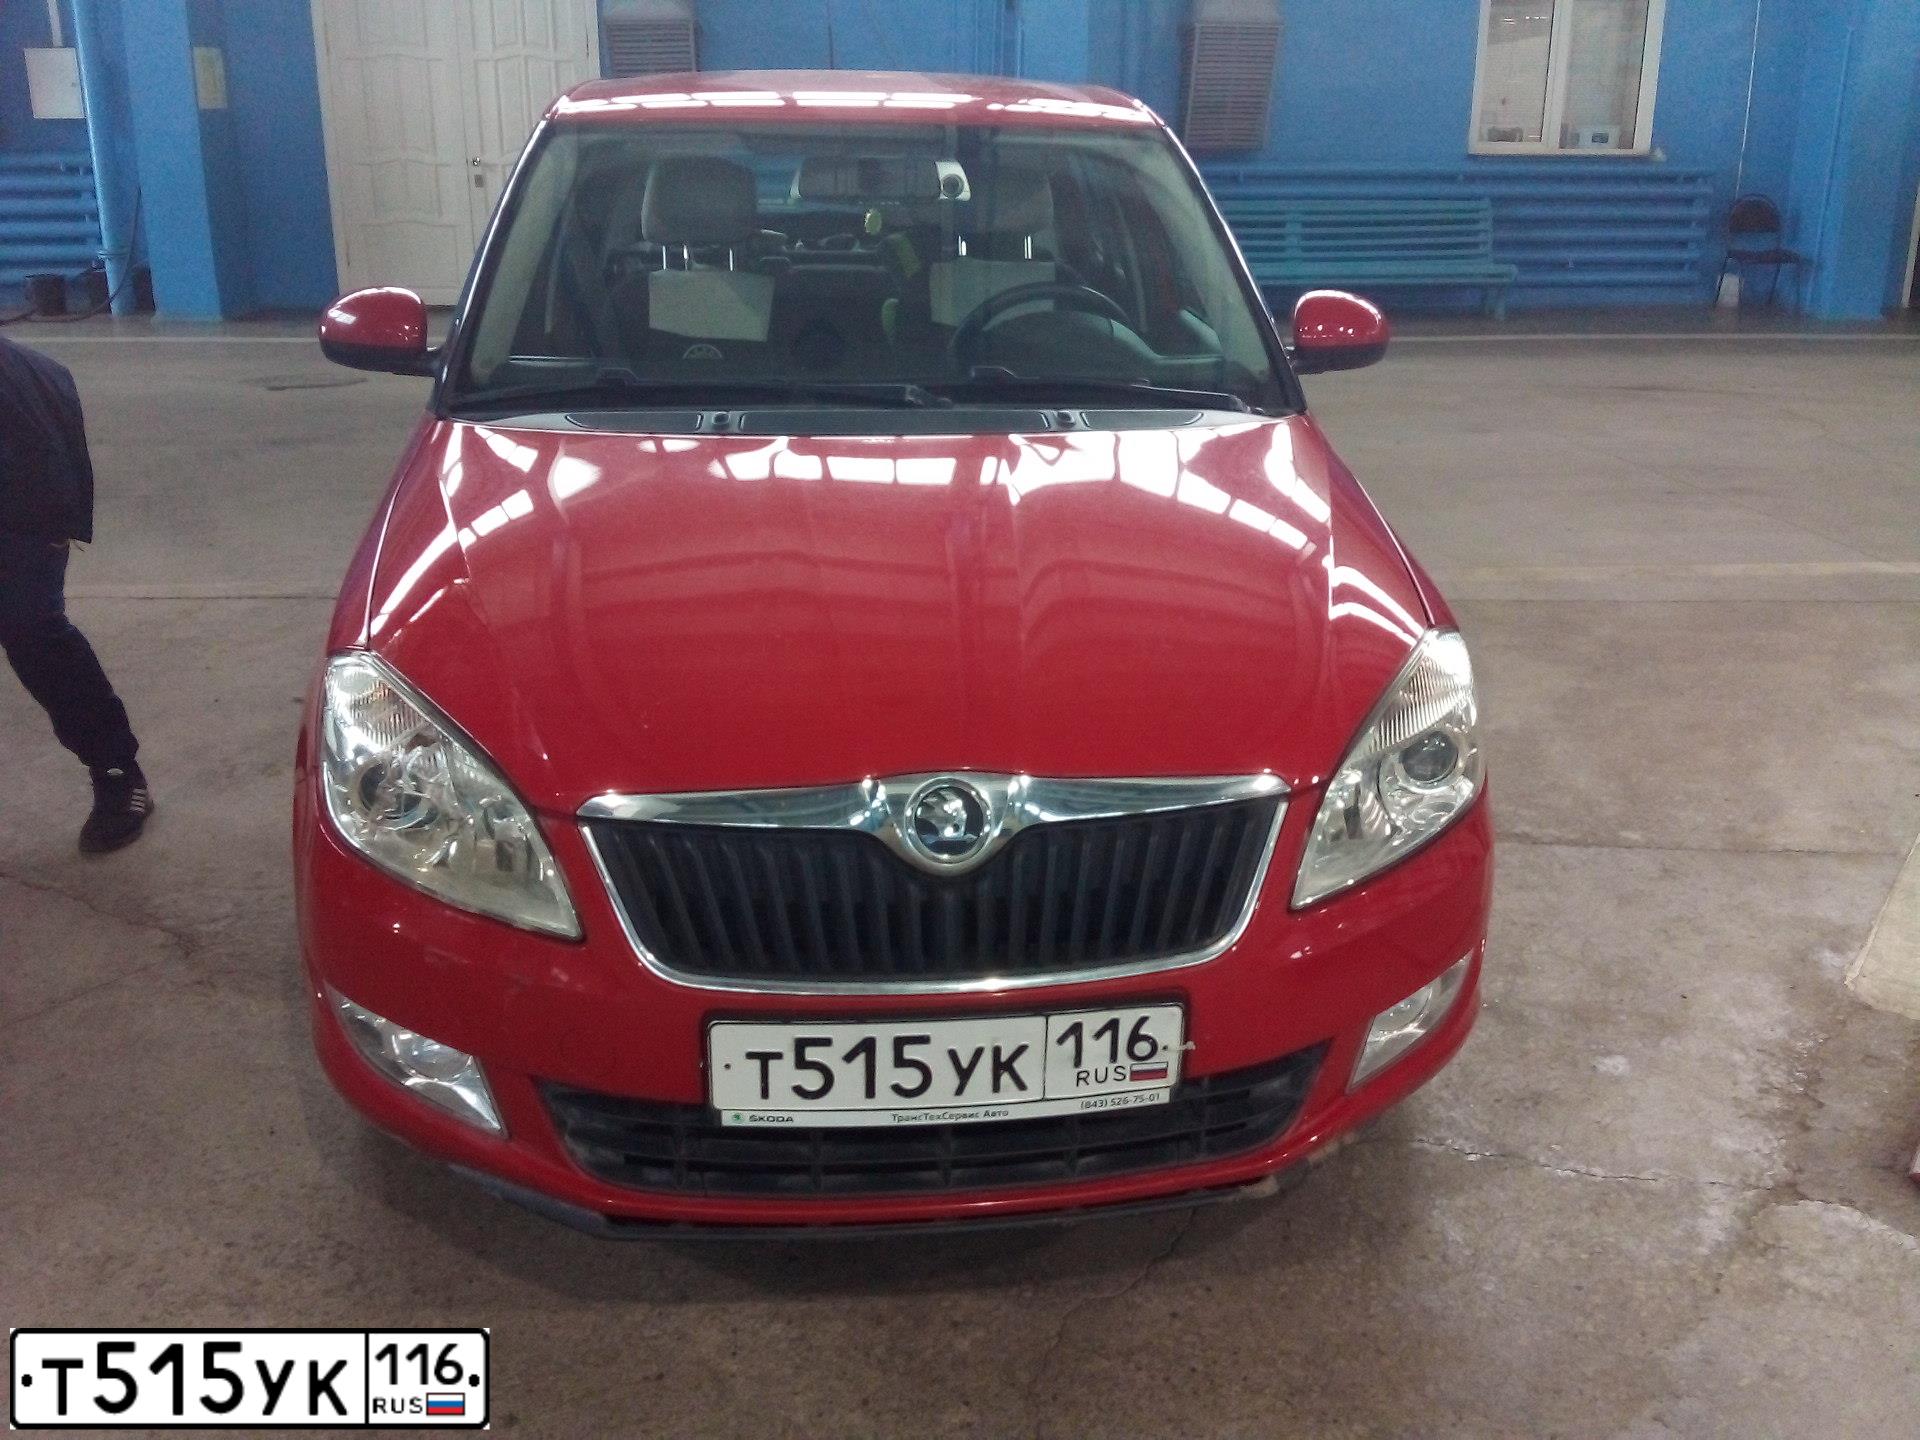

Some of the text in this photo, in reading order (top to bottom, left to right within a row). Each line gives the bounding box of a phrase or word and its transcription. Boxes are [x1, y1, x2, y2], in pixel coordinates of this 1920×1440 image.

[1055, 1015, 1159, 1068] 116
[1076, 1065, 1127, 1087] RUS
[1080, 1099, 1108, 1110] (843)
[983, 1109, 1009, 1118] Авто
